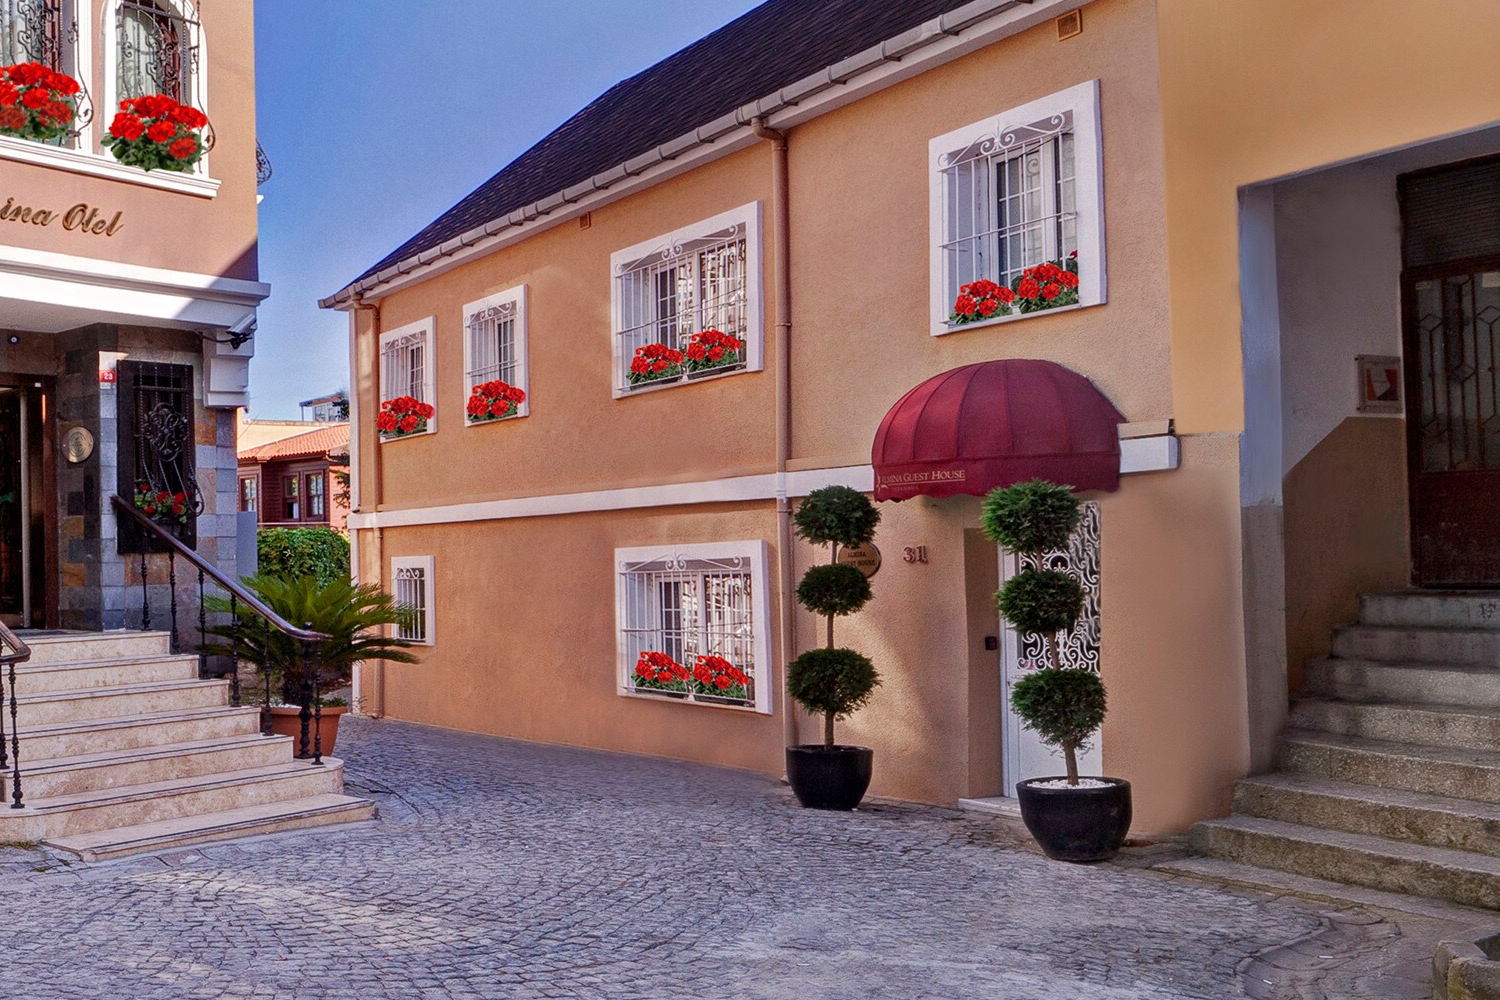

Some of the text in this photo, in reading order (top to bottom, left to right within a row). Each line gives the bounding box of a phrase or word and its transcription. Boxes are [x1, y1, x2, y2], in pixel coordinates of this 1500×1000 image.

[62, 203, 124, 237] Otel
[903, 472, 929, 482] GUEST
[932, 470, 965, 480] HOUSE
[903, 545, 927, 564] 31
